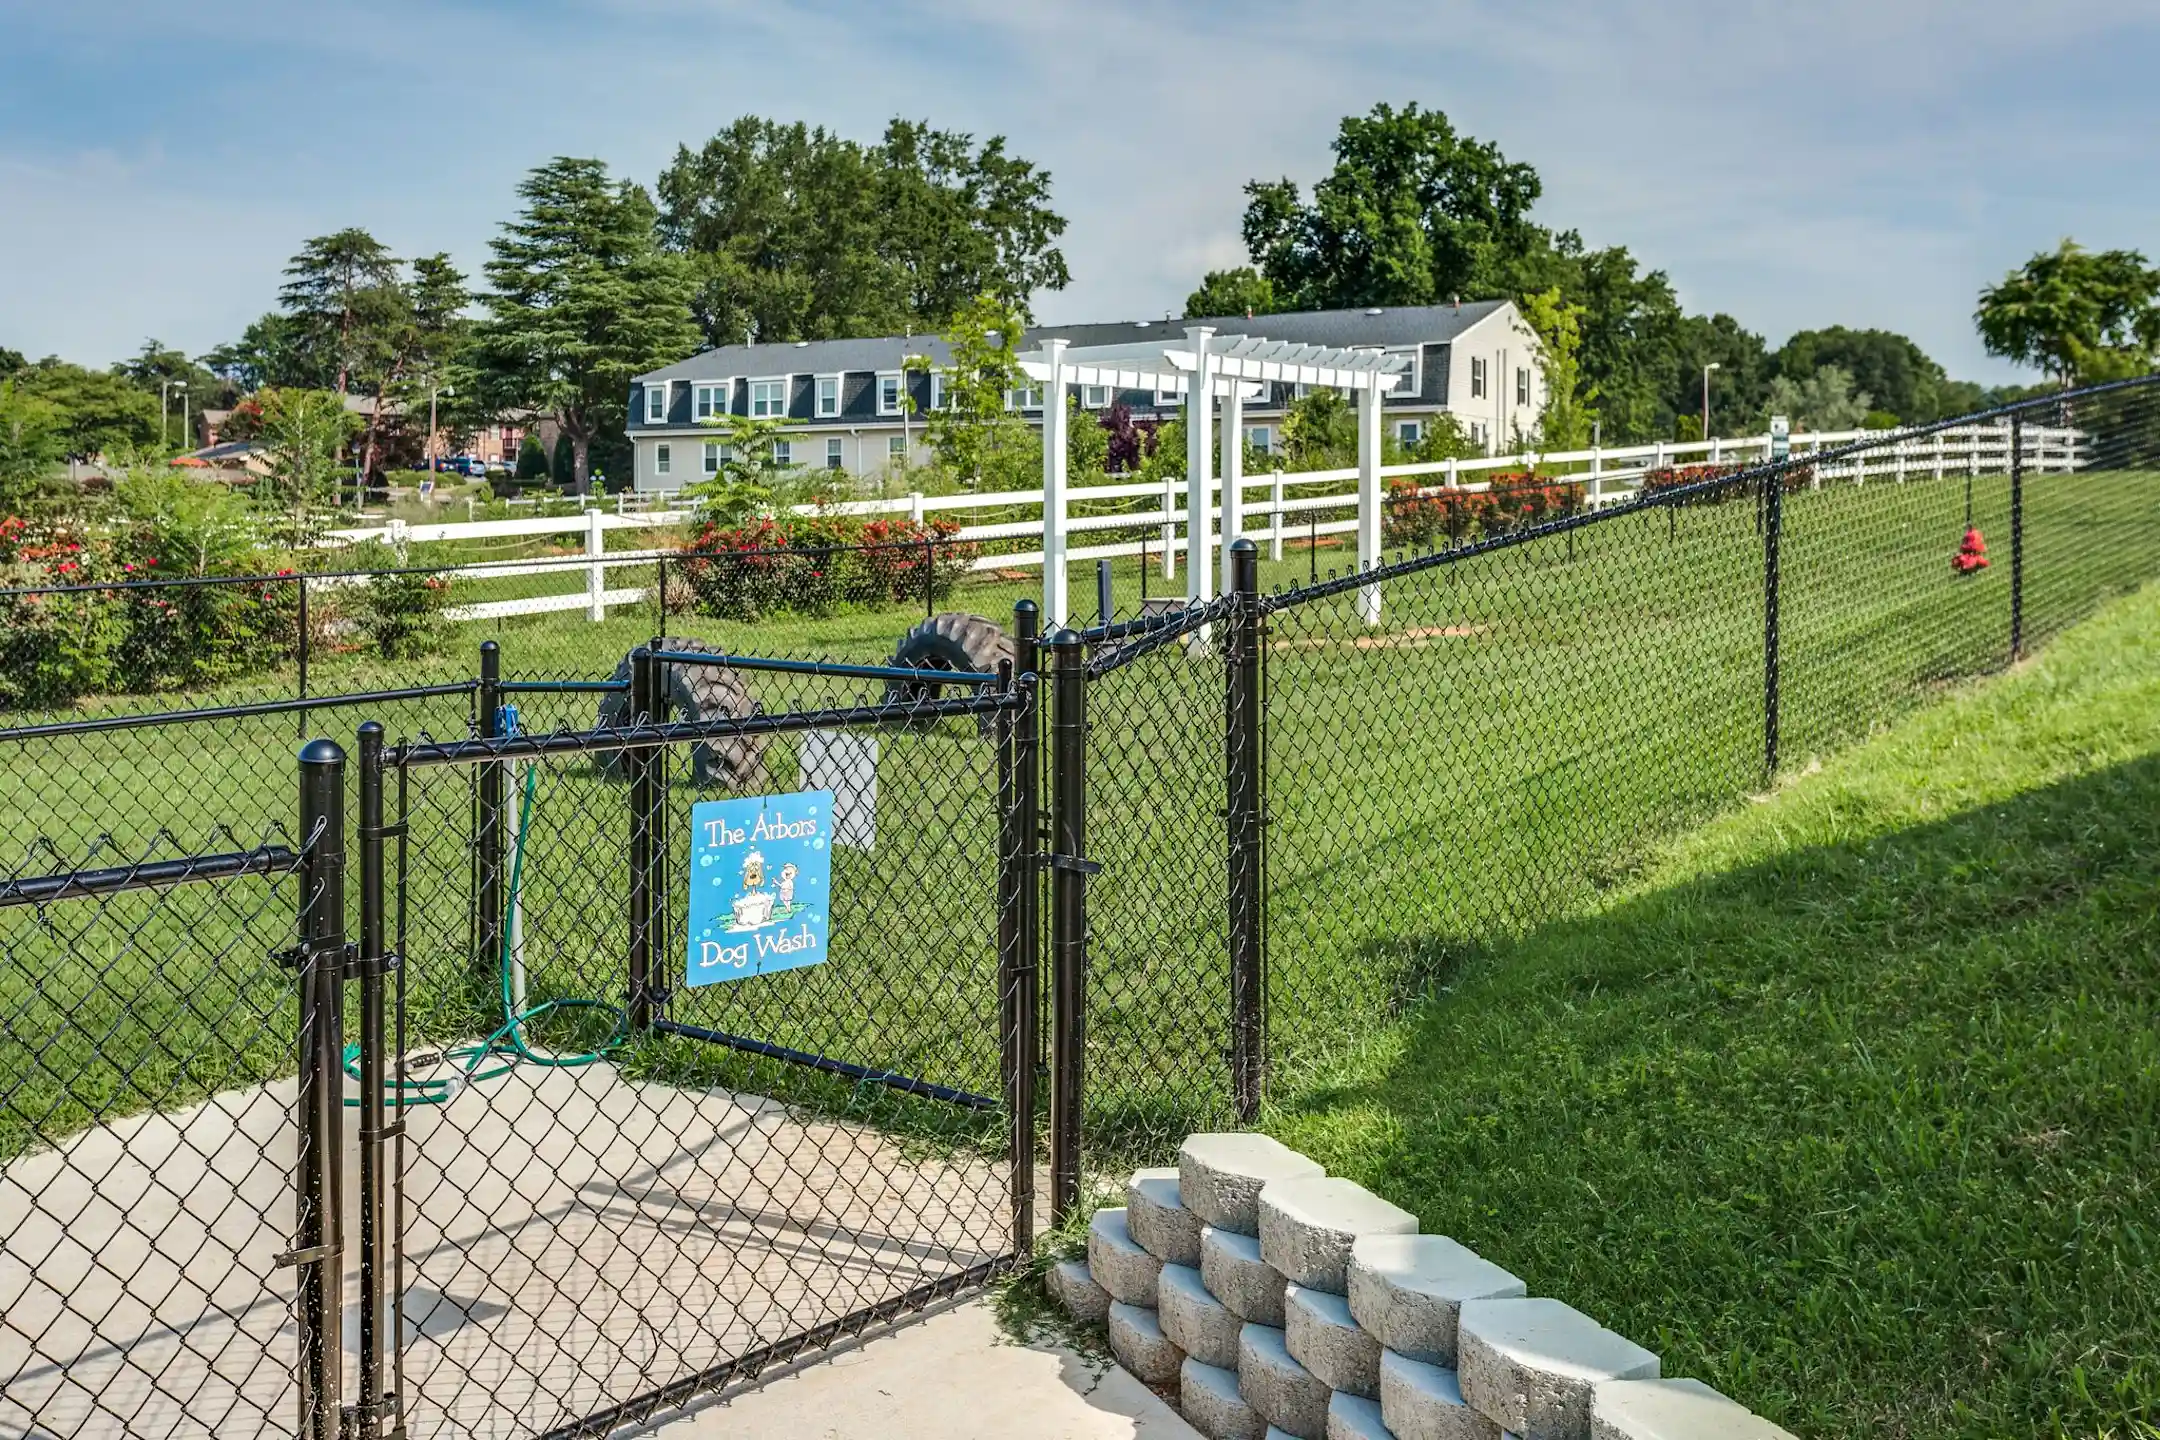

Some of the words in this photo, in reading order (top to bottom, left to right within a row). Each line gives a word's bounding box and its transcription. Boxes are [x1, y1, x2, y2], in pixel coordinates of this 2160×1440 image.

[704, 818, 746, 848] The
[750, 812, 817, 842] Arbors
[699, 941, 749, 968] Dog
[753, 923, 817, 958] Wash
